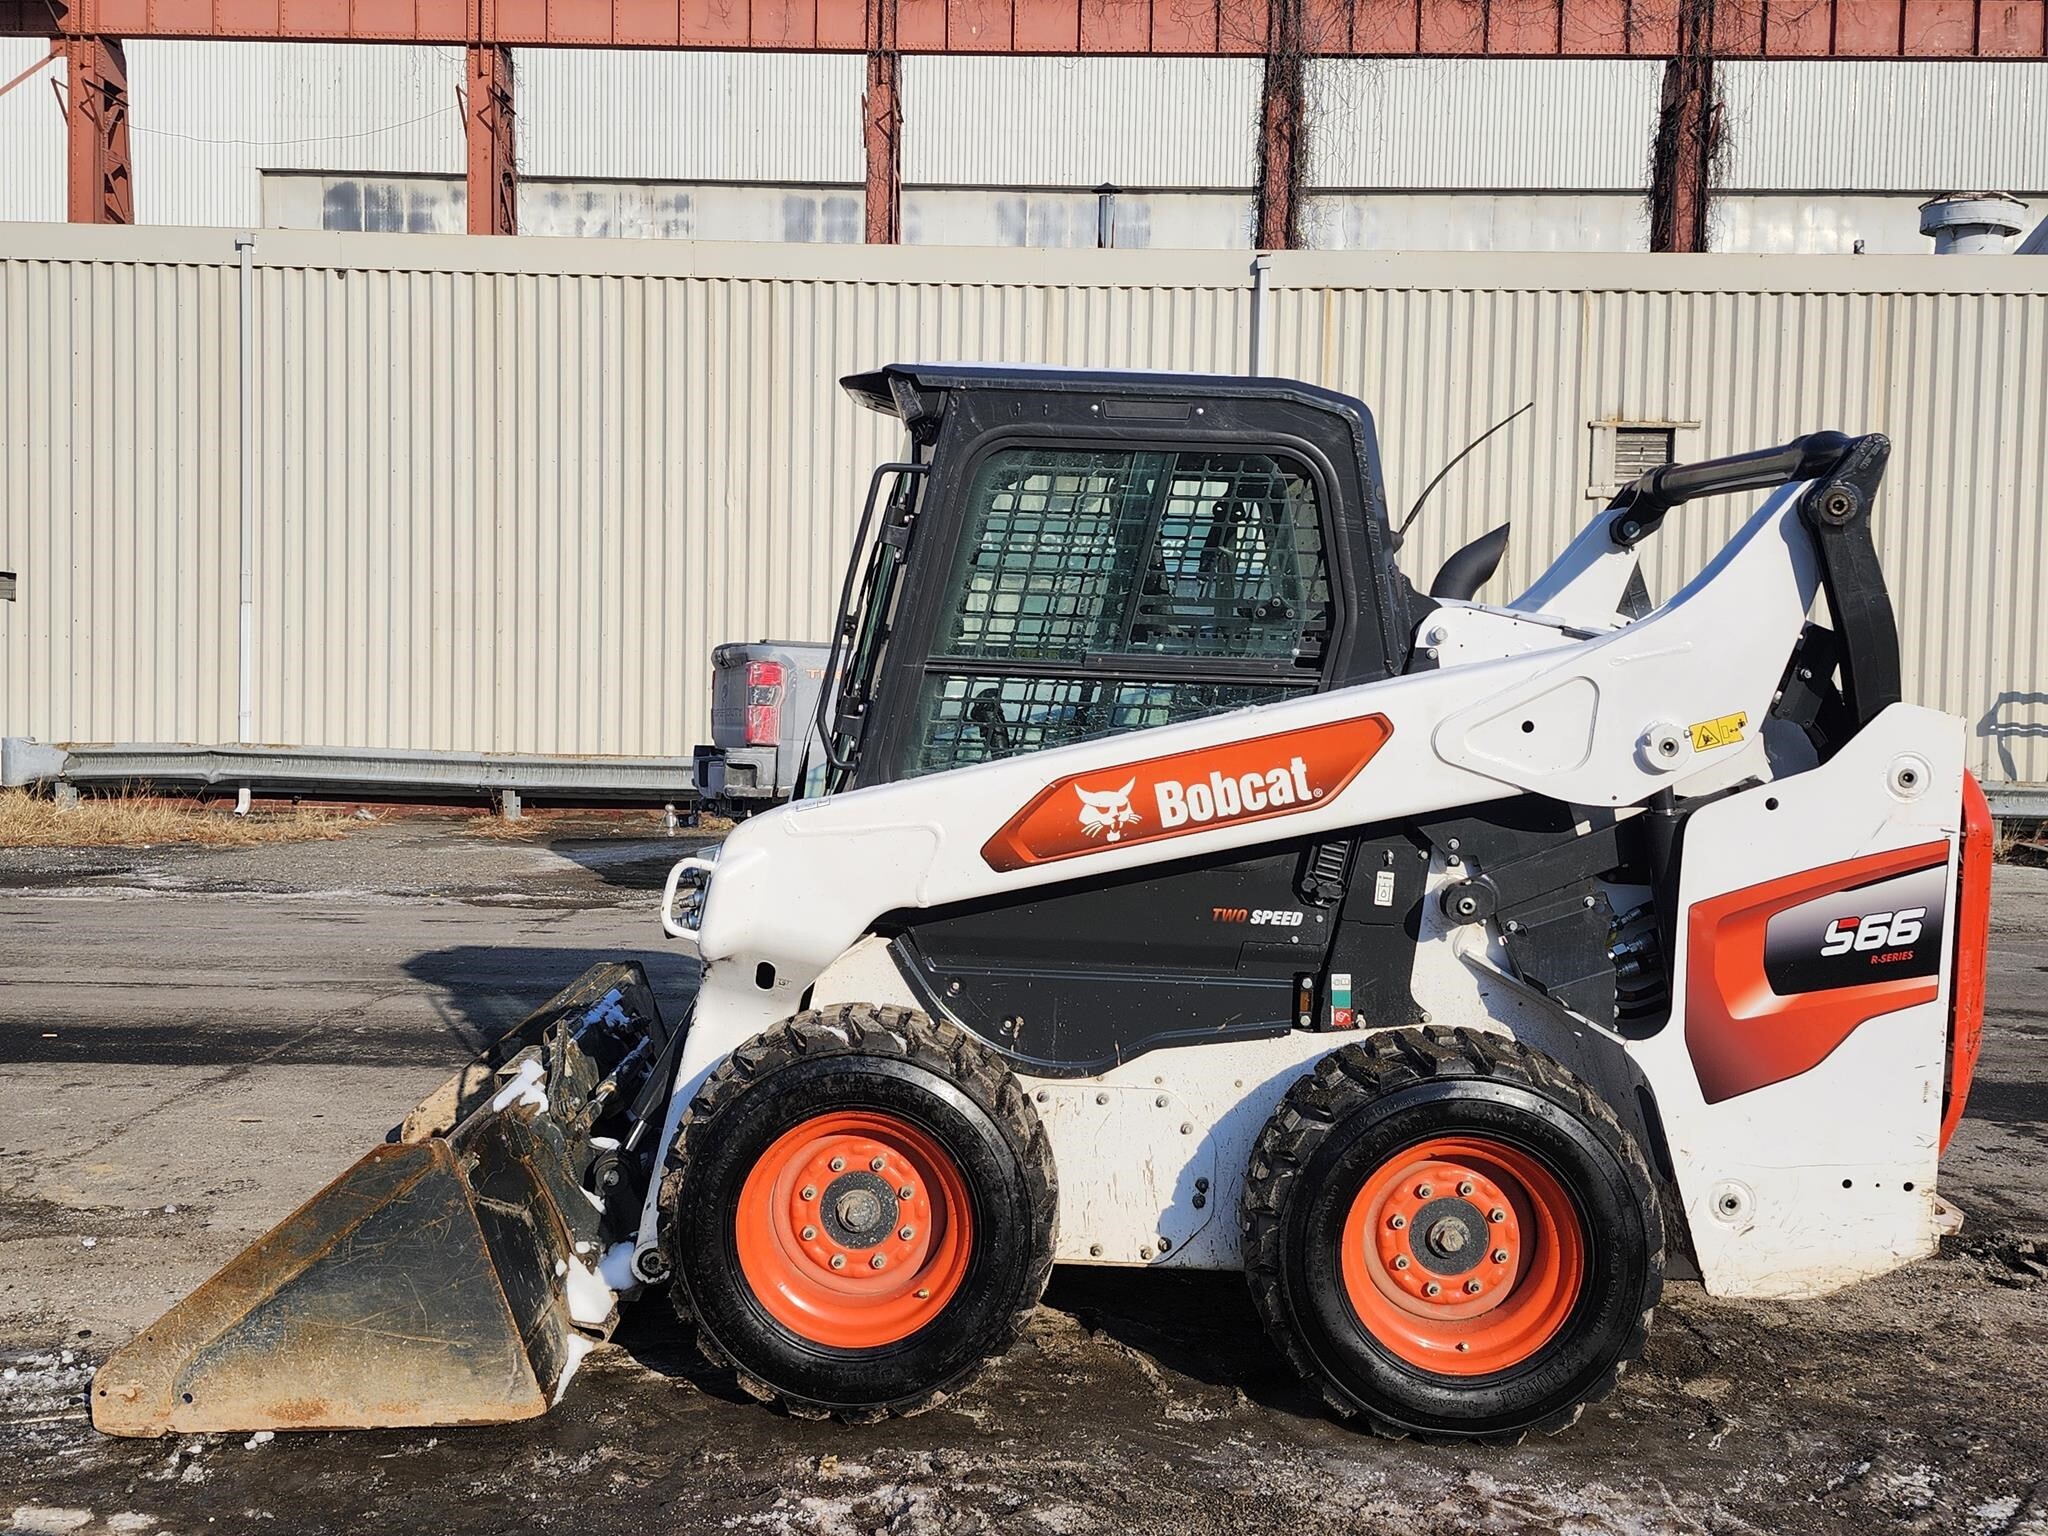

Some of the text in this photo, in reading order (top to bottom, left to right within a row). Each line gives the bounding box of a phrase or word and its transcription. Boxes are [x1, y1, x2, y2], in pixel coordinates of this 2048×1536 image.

[1154, 756, 1312, 828] Bobcat
[1212, 908, 1303, 926] TWO SPEED
[1821, 908, 1926, 956] S66
[1871, 951, 1914, 965] R-SERIES
